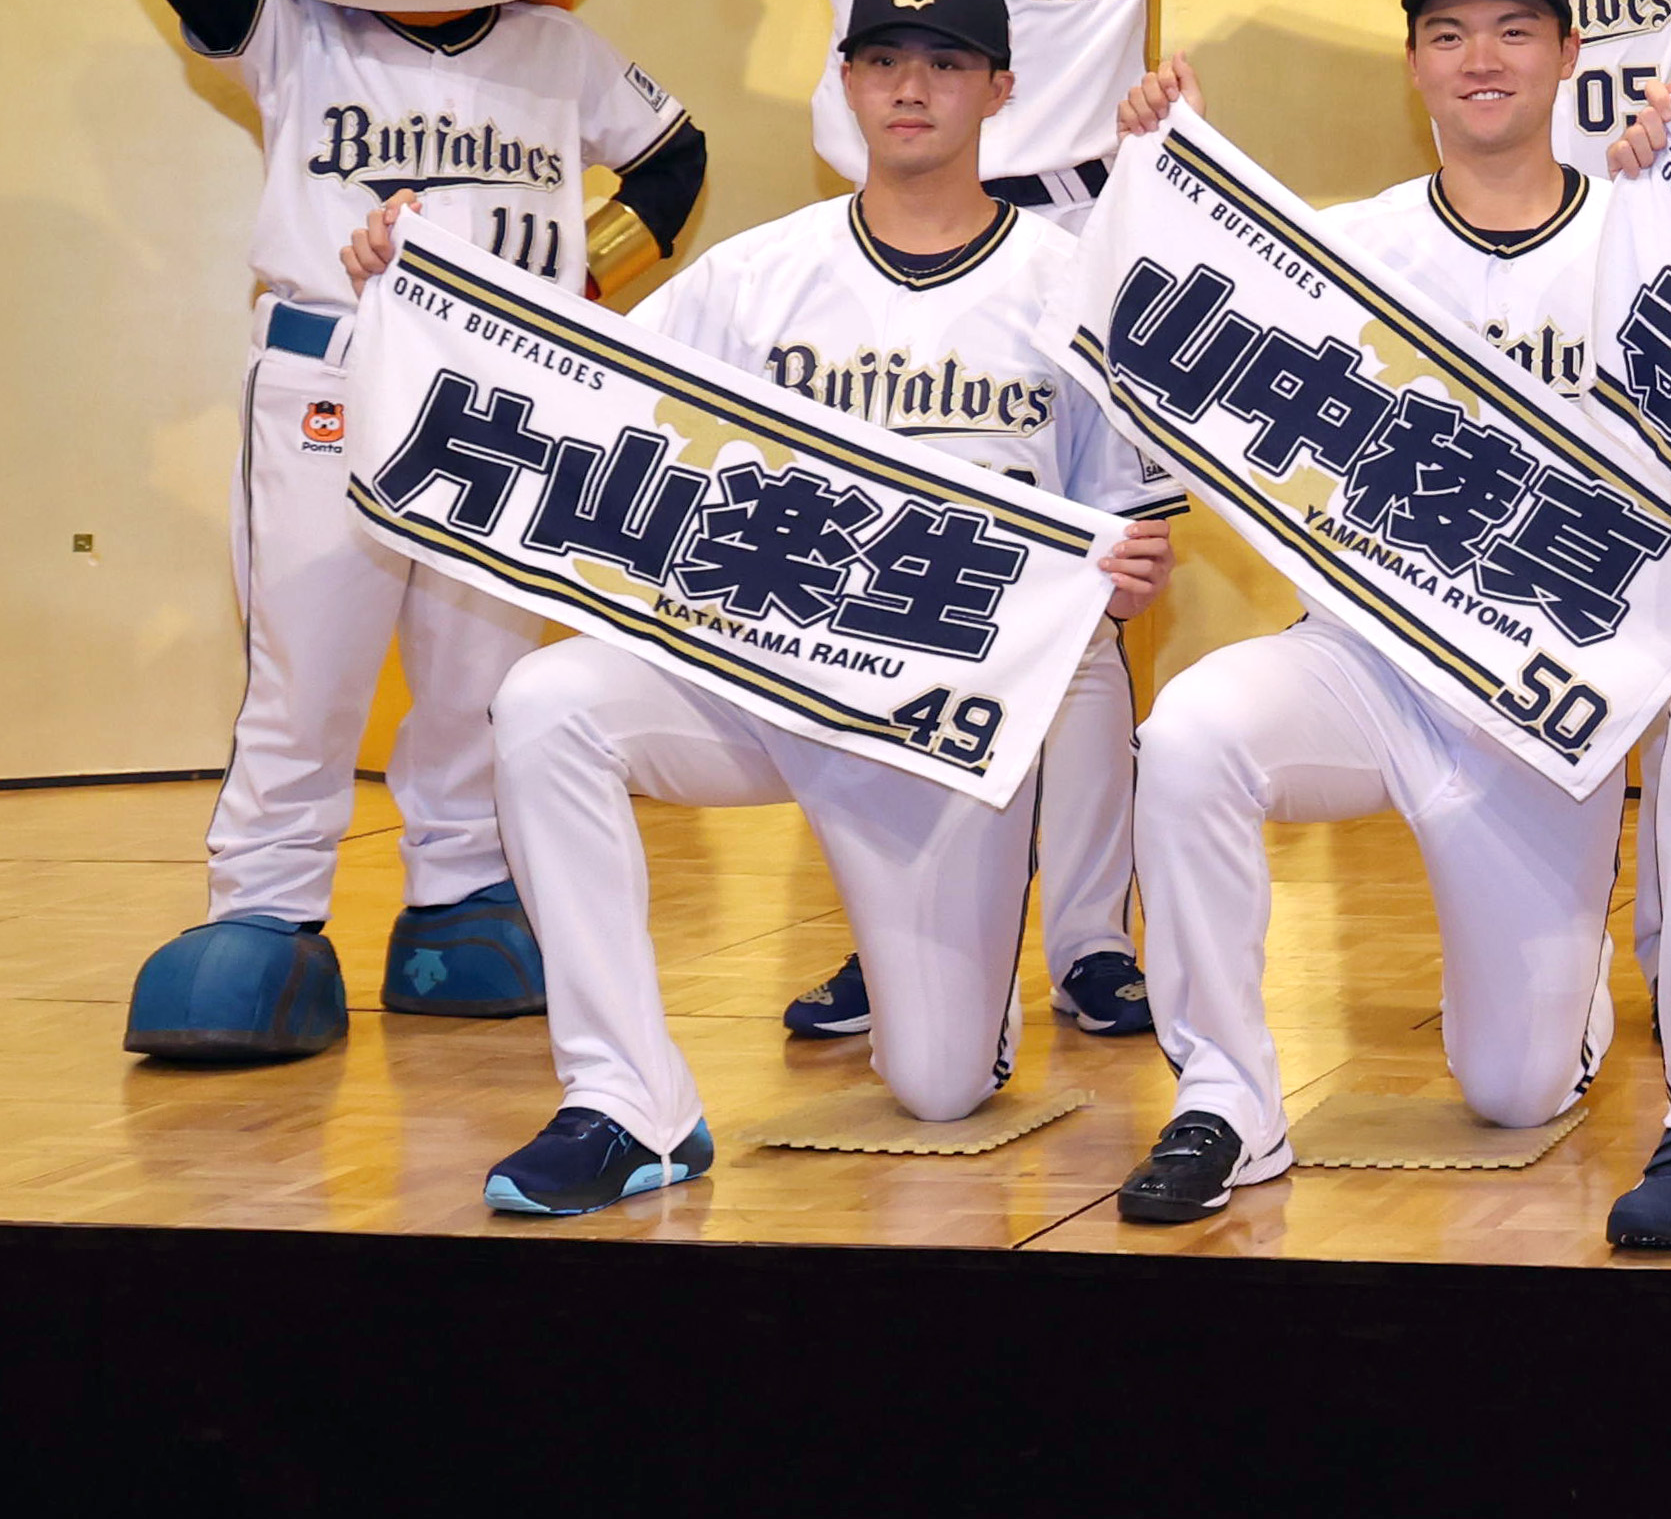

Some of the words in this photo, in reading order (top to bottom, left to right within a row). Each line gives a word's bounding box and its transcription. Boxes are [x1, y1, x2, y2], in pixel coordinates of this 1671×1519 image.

[307, 104, 564, 194] Buffaloes
[491, 205, 562, 279] 111
[1154, 151, 1204, 206] ORIX
[1209, 200, 1327, 301] BUFFALOES
[393, 275, 457, 323] ORIX
[463, 311, 607, 391] BUFFALOES
[766, 341, 1056, 438] Buffaloes
[301, 441, 343, 454] Ponta
[371, 368, 1030, 662] 片山楽生
[1302, 502, 1439, 599] YAMANAKA
[1441, 584, 1535, 649] RYOMA
[653, 591, 803, 661] KATAYAMA
[809, 642, 907, 680] RAIKU
[887, 683, 1010, 769] 49
[1492, 648, 1611, 754] 50
